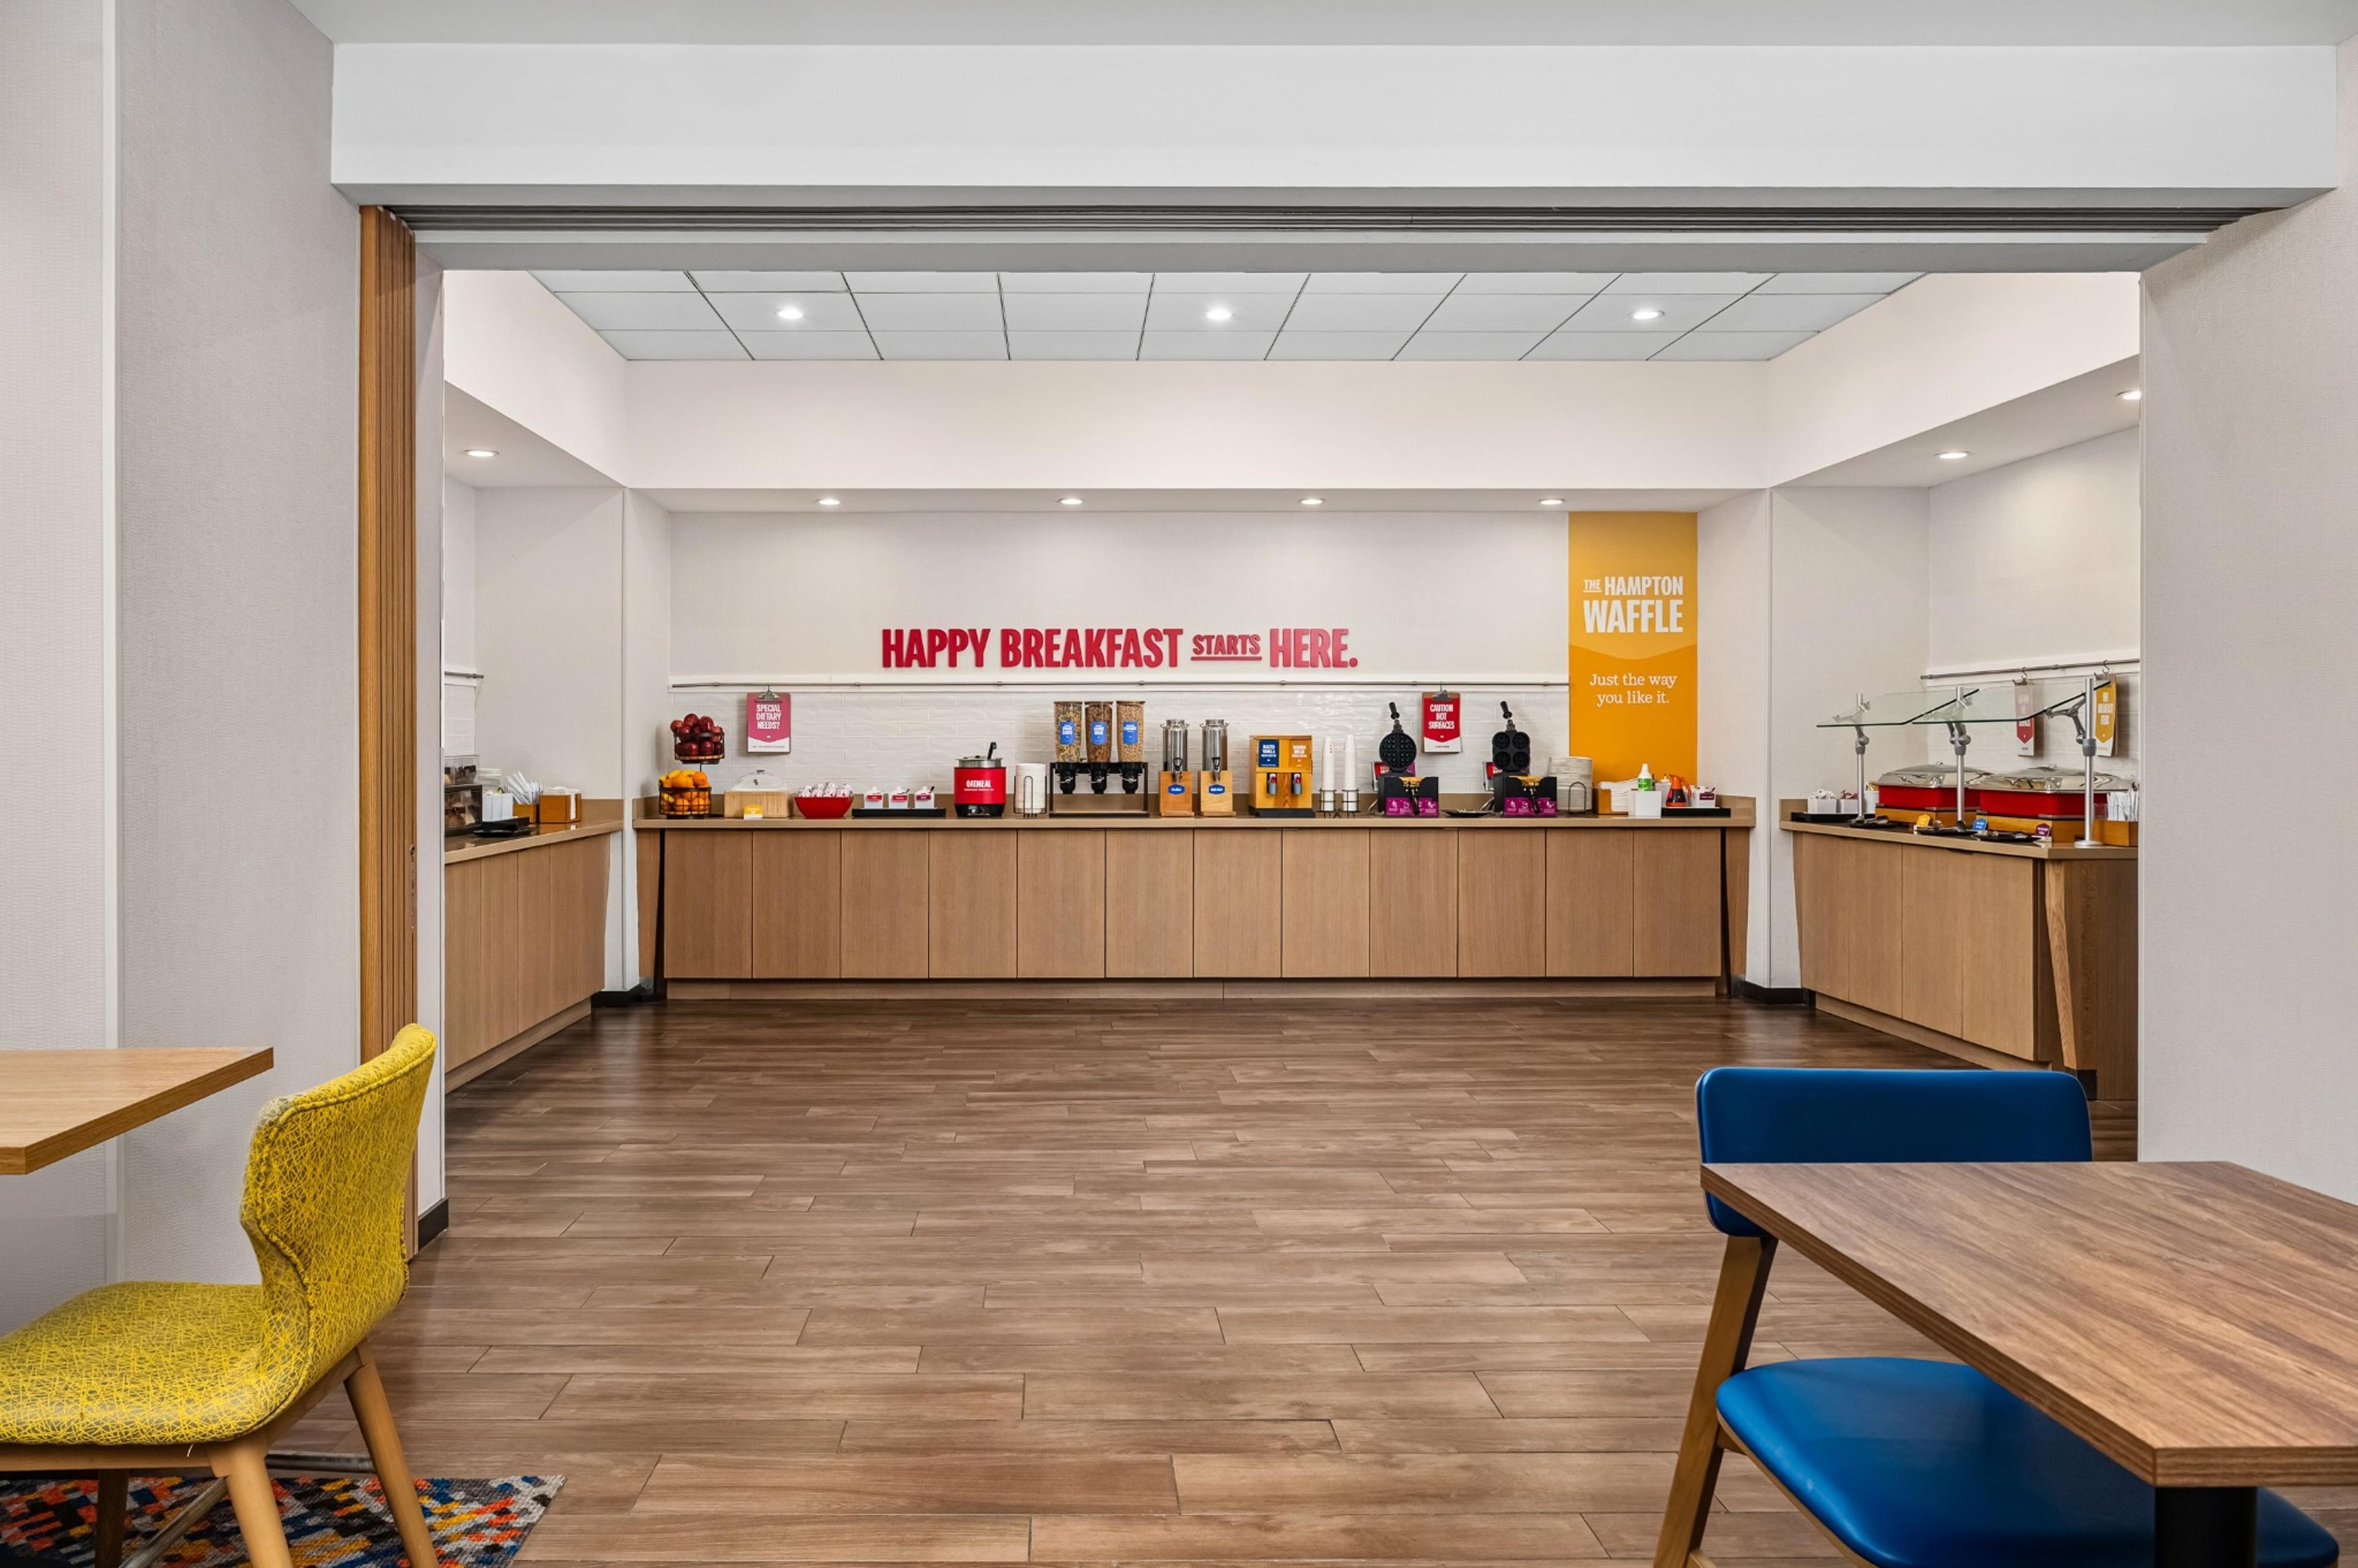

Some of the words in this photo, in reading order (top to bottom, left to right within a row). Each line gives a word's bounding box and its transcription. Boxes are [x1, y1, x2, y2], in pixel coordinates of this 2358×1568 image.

[1583, 579, 1601, 590] THE
[1604, 576, 1684, 596] HAMPTON
[1582, 599, 1684, 634] WAFFLE
[882, 628, 991, 668] HAPPY
[1000, 628, 1184, 668] BREAKFAST
[1192, 634, 1261, 655] STARTS
[1269, 628, 1358, 668] HERE.
[1589, 673, 1619, 686] Just
[1622, 673, 1646, 686] the
[1648, 675, 1678, 689] way
[1597, 693, 1624, 707] you
[1627, 691, 1653, 704] like
[1656, 691, 1670, 704] it.
[756, 704, 781, 712] SPECIAL
[1430, 704, 1453, 712] CAUTION
[756, 712, 781, 721] DIETARY
[1428, 721, 1455, 729] SURFACES
